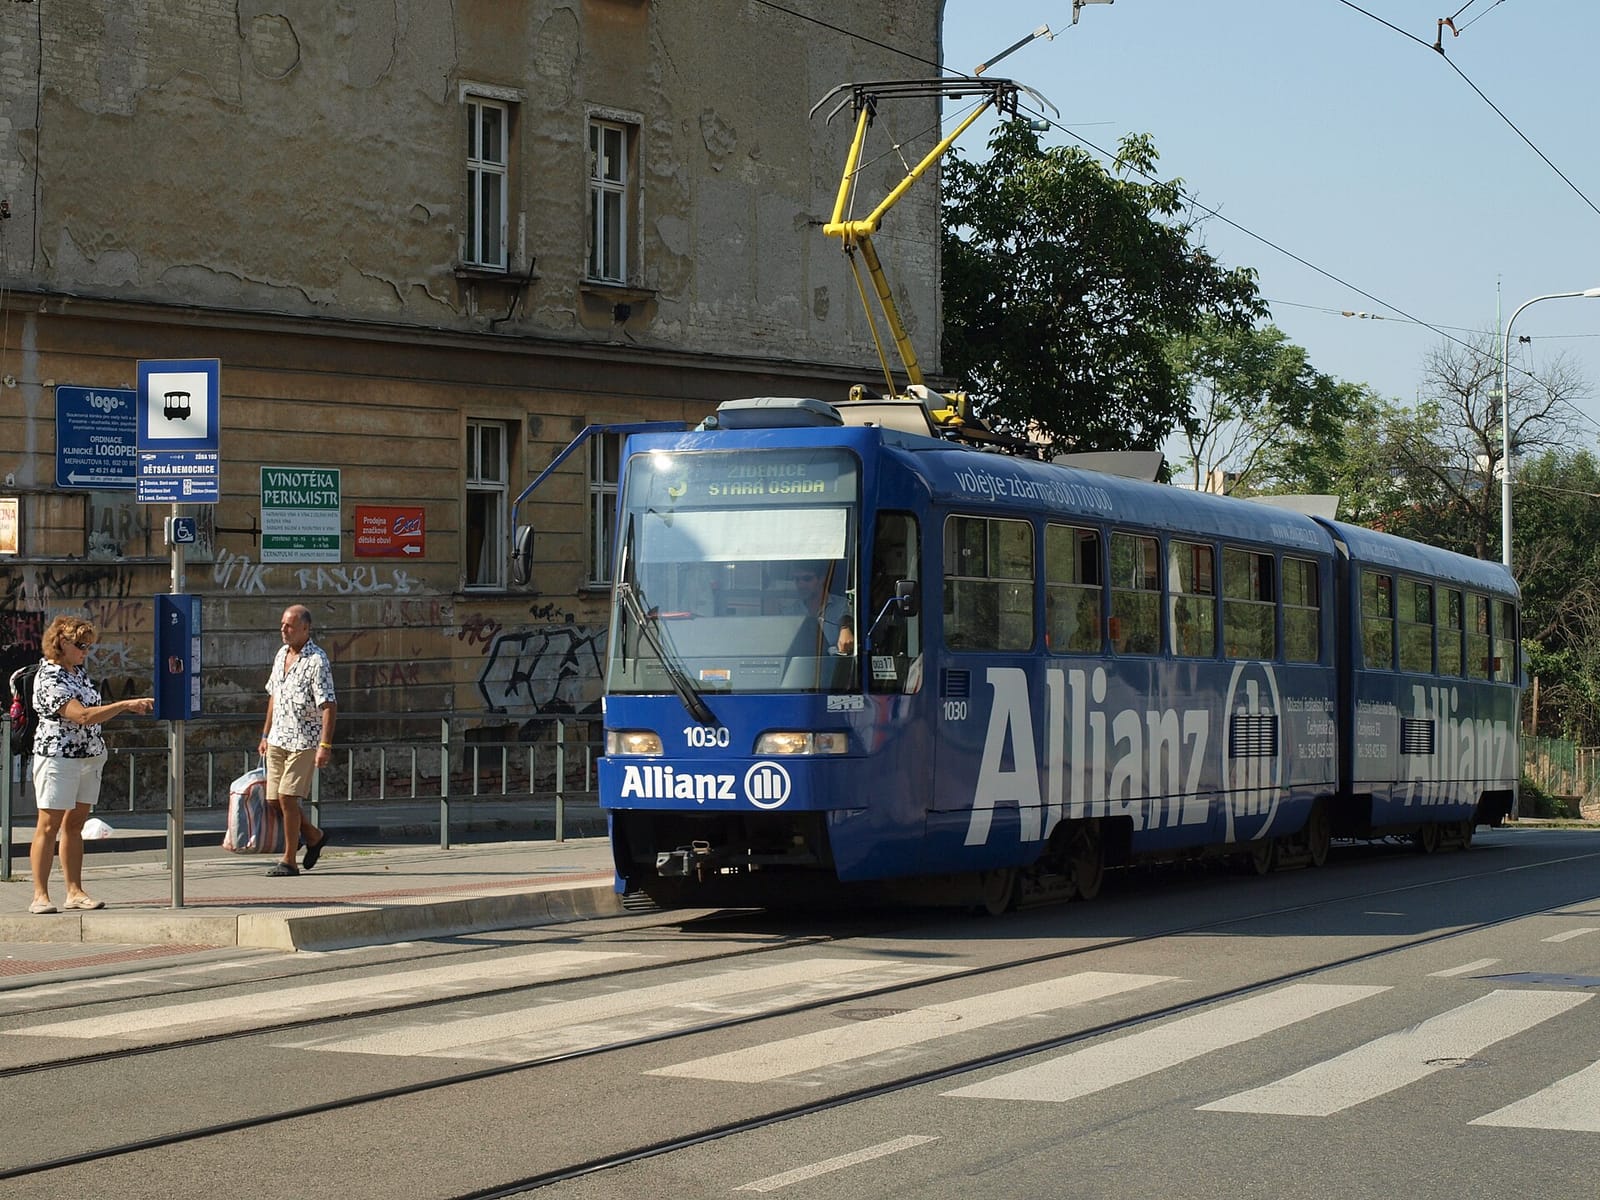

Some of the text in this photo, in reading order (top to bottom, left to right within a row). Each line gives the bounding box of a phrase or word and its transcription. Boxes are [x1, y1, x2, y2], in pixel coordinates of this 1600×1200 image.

[90, 392, 119, 413] logo
[90, 436, 122, 444] ORDINACE
[144, 464, 214, 474] DĚTSKÁ NEMOCNICE
[267, 470, 334, 488] VINOTÉKA
[708, 479, 824, 496] STARÁ OSADA
[954, 466, 1007, 502] volejte
[1006, 473, 1055, 502] zdarma
[264, 490, 338, 505] PERKMISTR
[943, 701, 967, 720] 1030
[683, 726, 730, 748] 1030
[1404, 684, 1507, 806] Allianz
[964, 666, 1209, 847] Allianz
[620, 766, 736, 804] Allianz
